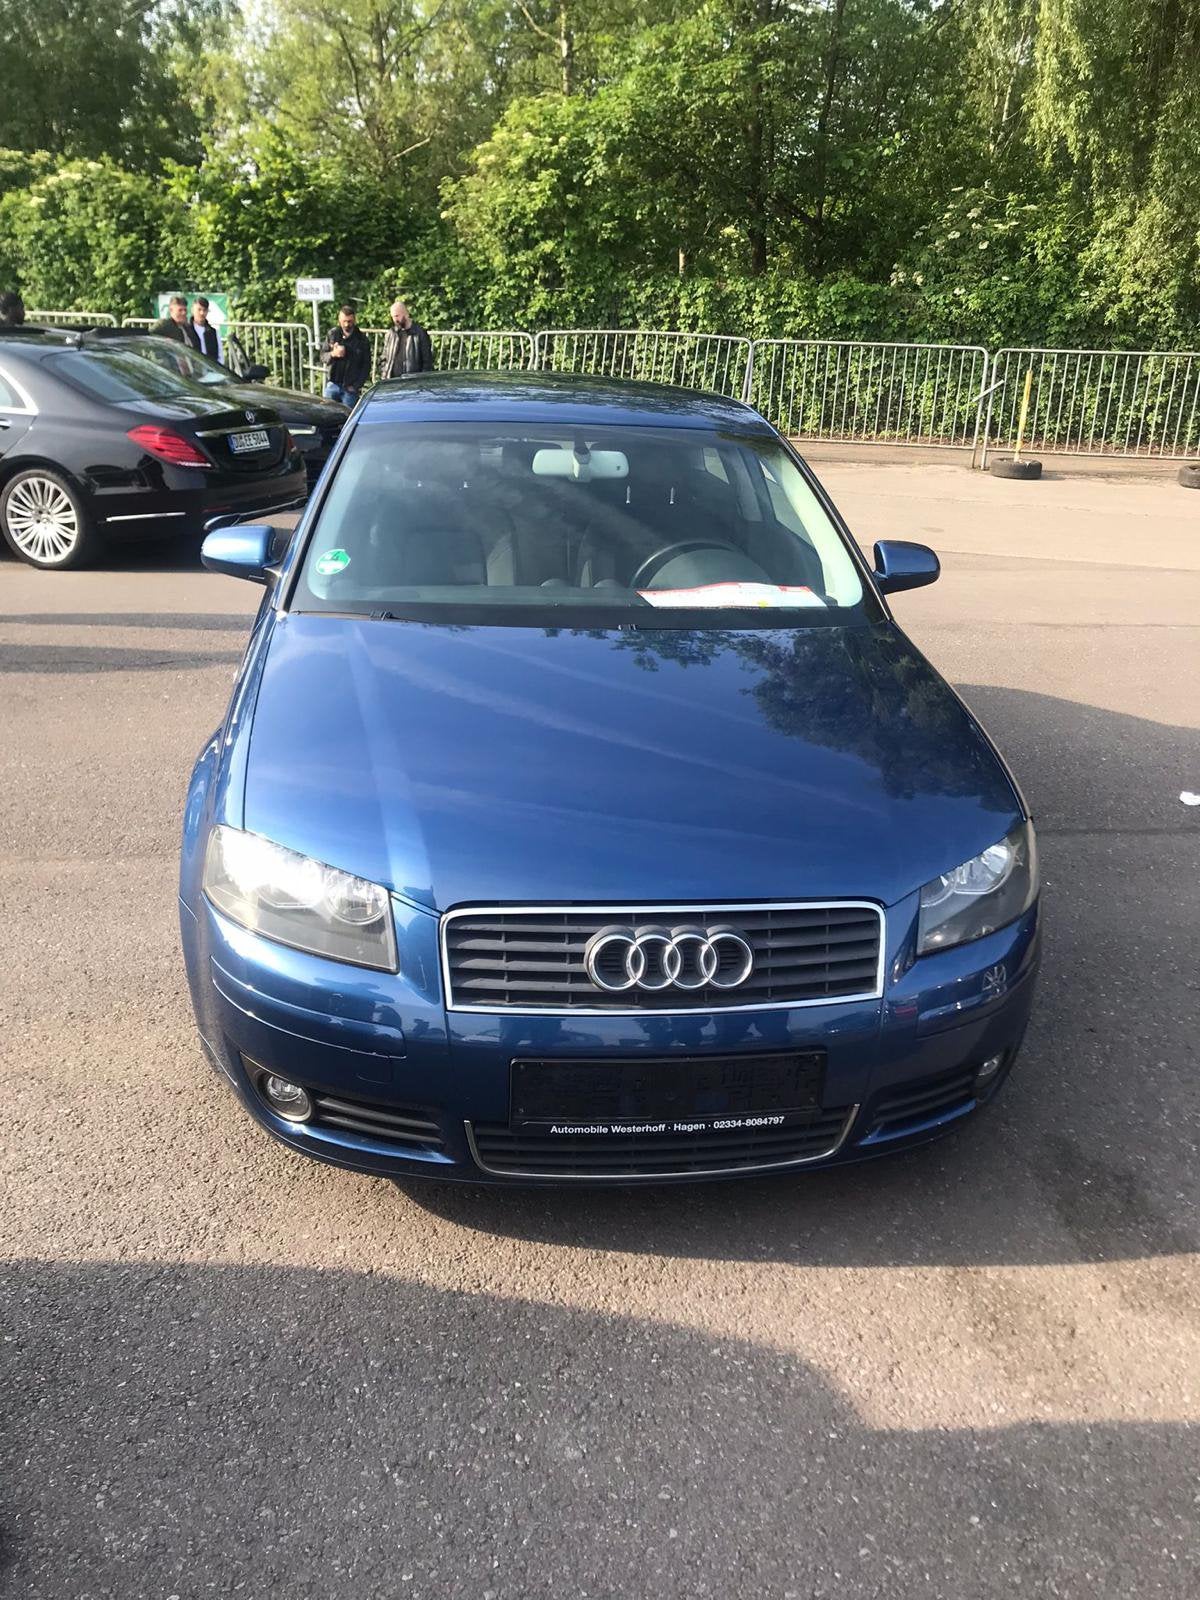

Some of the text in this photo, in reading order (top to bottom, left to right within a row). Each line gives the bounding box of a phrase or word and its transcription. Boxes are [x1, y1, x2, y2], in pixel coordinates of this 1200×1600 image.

[298, 284, 320, 295] Reihe
[550, 1125, 609, 1134] Automobile
[611, 1124, 666, 1133] Westerhoff
[673, 1123, 706, 1132] Hagen
